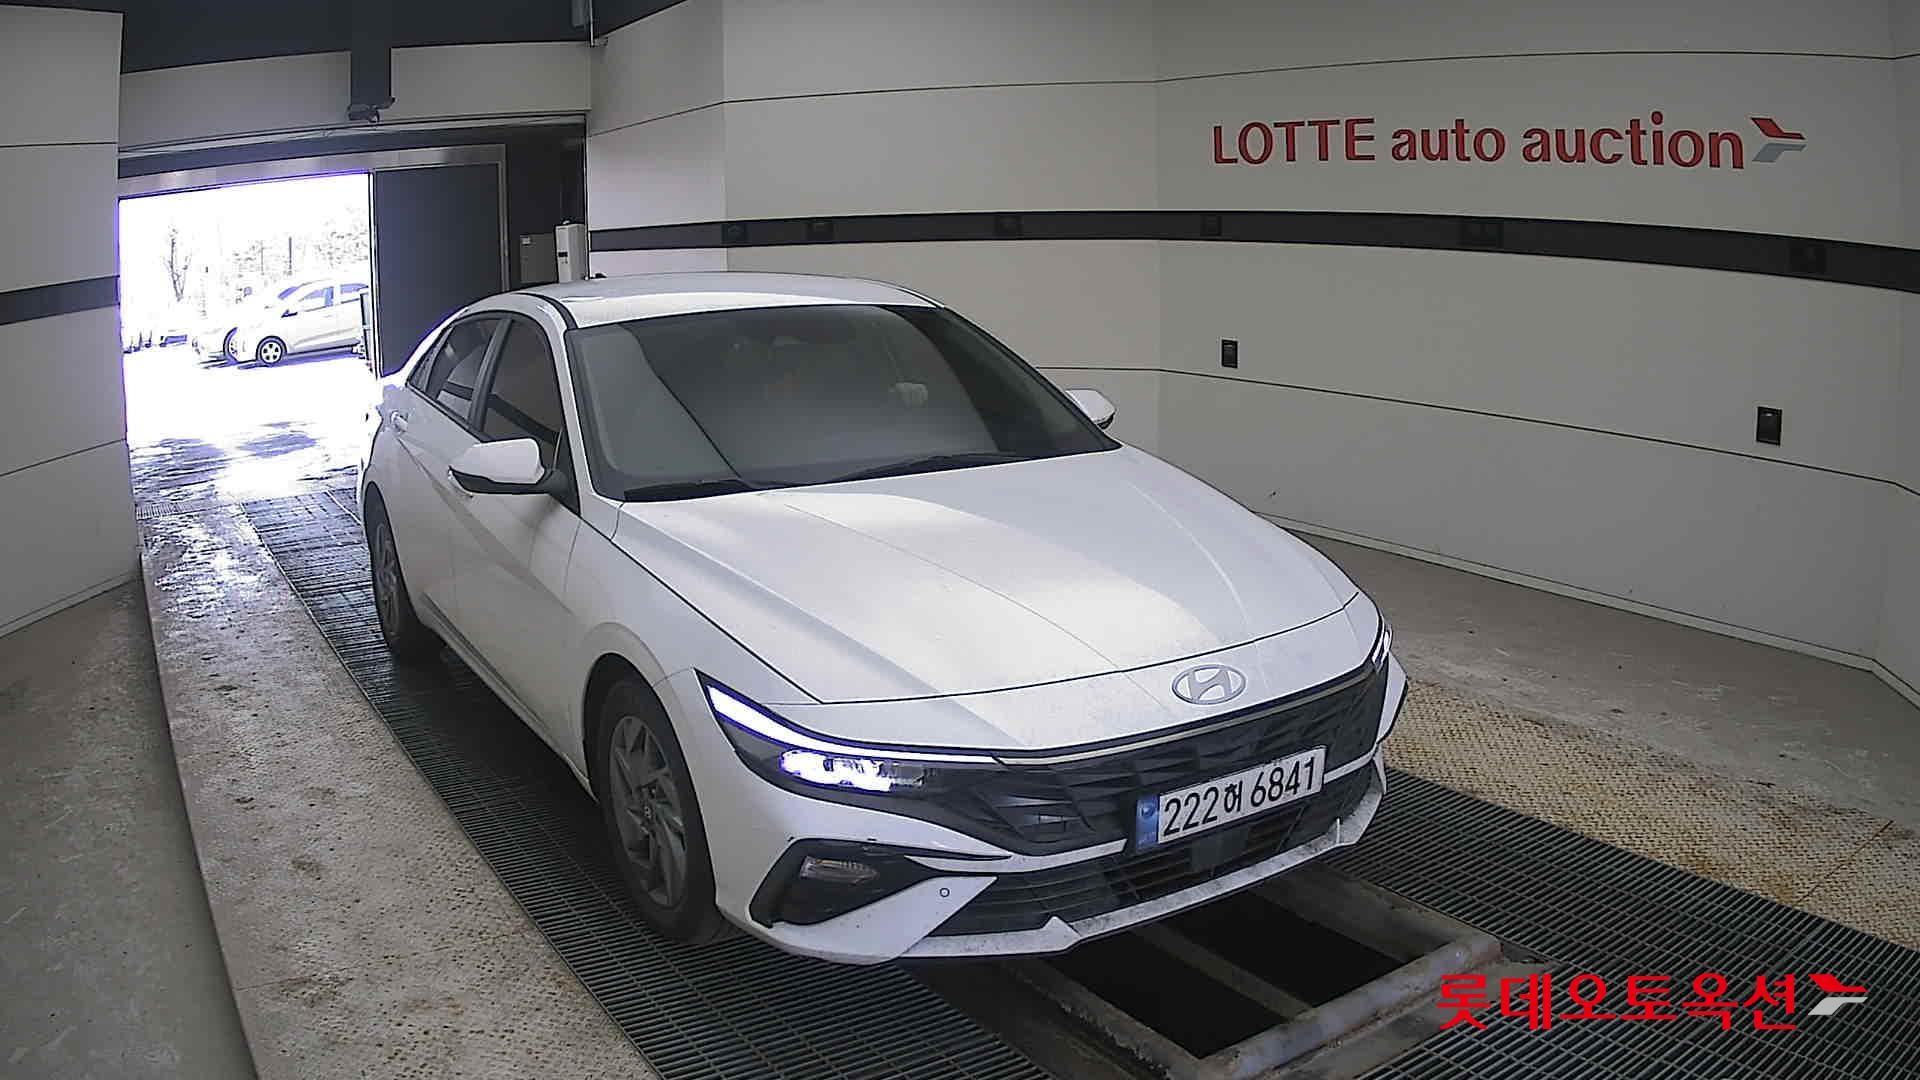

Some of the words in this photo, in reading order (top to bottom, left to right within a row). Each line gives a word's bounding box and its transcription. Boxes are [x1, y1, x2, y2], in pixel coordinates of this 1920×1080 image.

[1213, 118, 1376, 165] LOTTE
[1391, 117, 1506, 163] auto
[1522, 111, 1745, 169] auction
